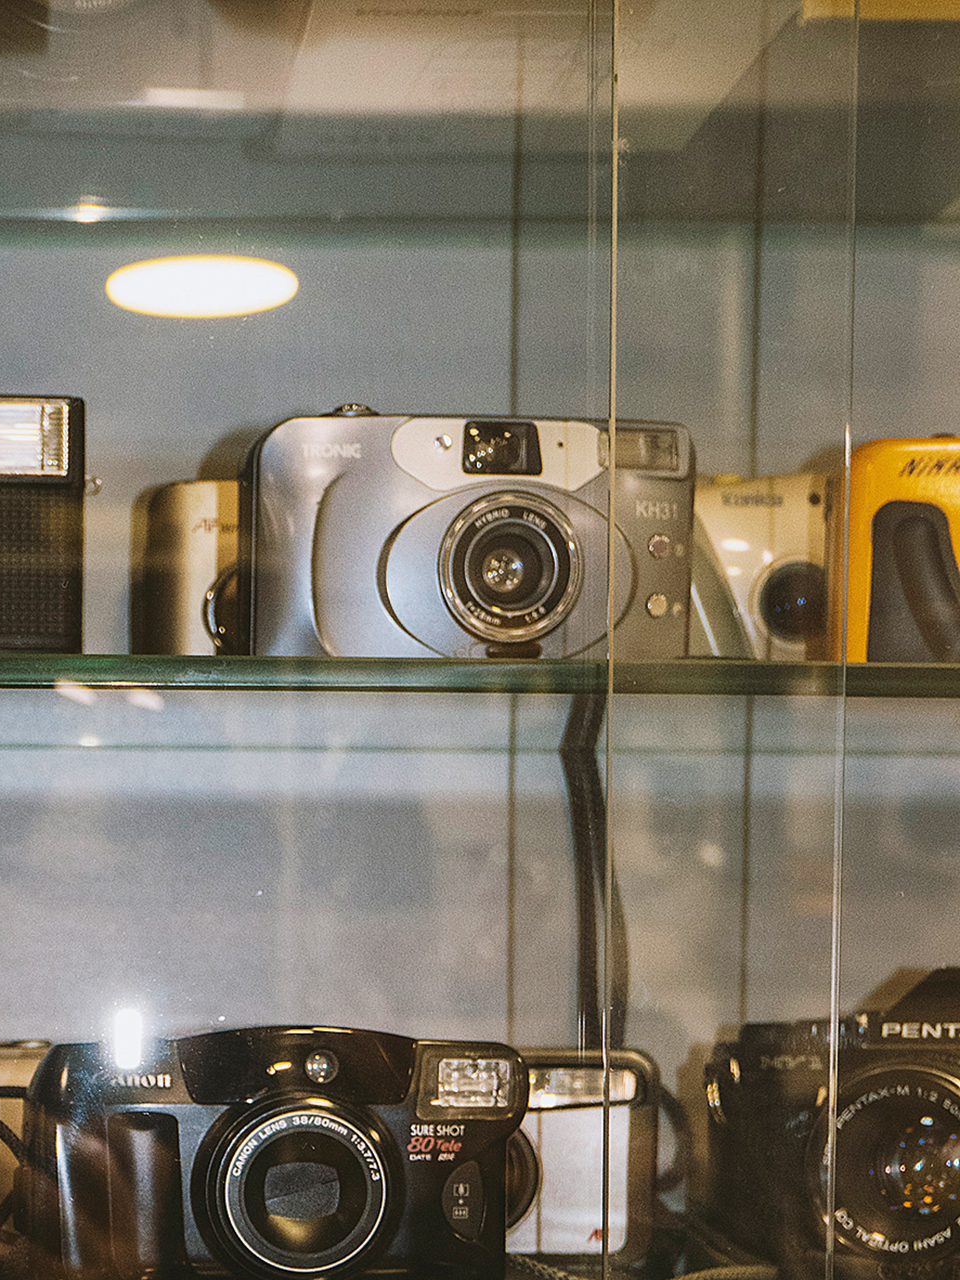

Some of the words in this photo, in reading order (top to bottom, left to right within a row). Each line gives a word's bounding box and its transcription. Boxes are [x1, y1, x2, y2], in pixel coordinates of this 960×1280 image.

[303, 442, 362, 459] TRONIC
[473, 507, 511, 529] HYBRID
[522, 511, 548, 530] LENS
[635, 500, 679, 521] KH31
[836, 1085, 910, 1131] PENTAX-M
[410, 1124, 435, 1136] SURE
[436, 1125, 465, 1136] SHOT
[232, 1138, 258, 1178] CANON
[258, 1119, 288, 1139] LENS
[292, 1116, 349, 1136] 38/80mm
[350, 1133, 380, 1182] 1:3.7/7.3
[407, 1136, 435, 1152] 80
[436, 1139, 463, 1152] Tele
[409, 1153, 432, 1161] DATE
[912, 1226, 952, 1252] ASAHI
